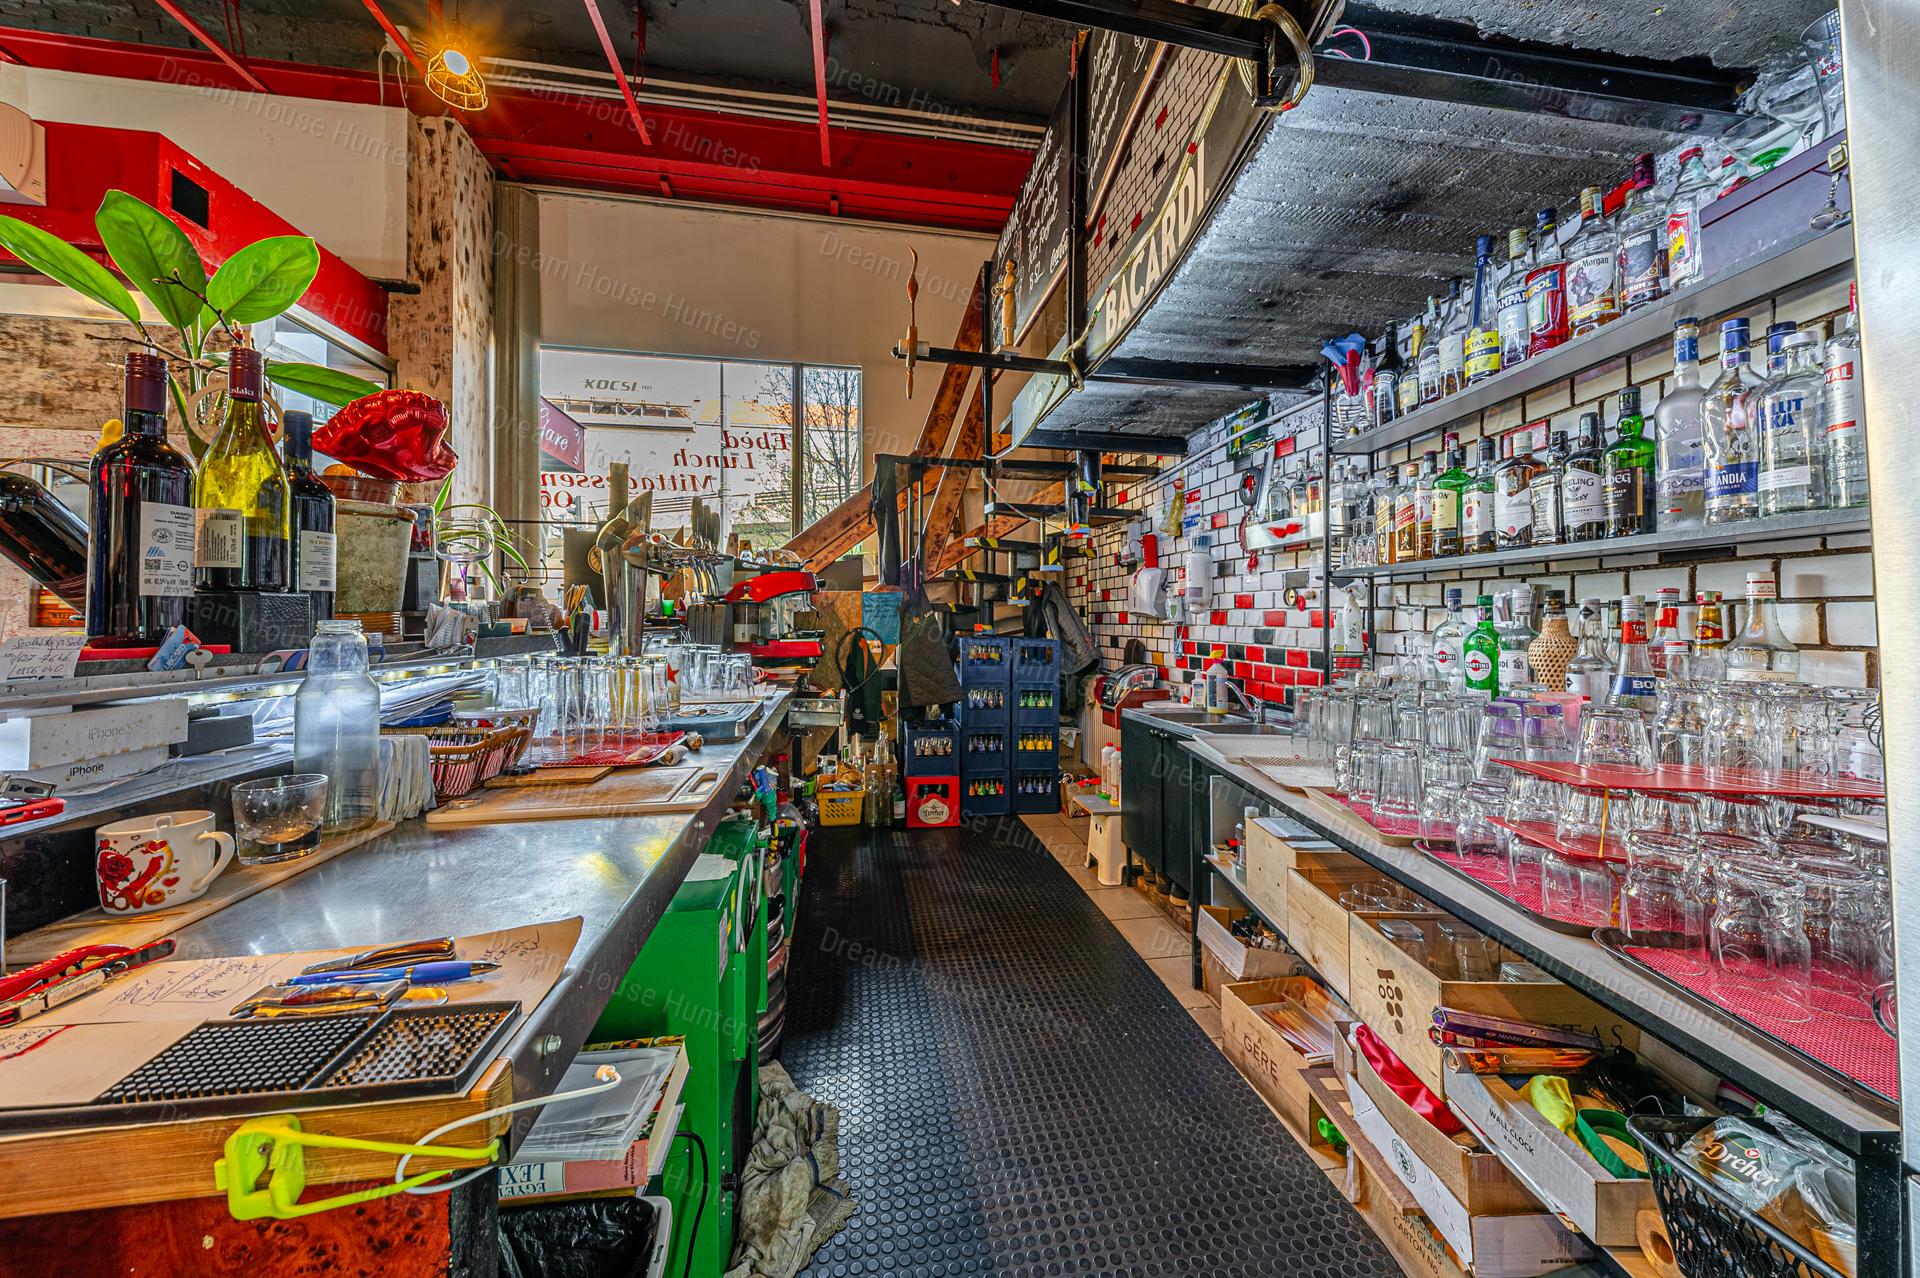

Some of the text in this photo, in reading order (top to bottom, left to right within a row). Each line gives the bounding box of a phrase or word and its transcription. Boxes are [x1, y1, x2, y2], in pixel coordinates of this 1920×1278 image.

[1105, 138, 1205, 342] BACARDI
[1622, 233, 1652, 249] Morgan
[1582, 256, 1610, 269] Morgan
[1703, 471, 1747, 489] FINLANDIA
[69, 763, 105, 777] iPhone
[1243, 1035, 1279, 1087] GERE
[1488, 1107, 1535, 1157] WALL CLOCK
[1703, 1141, 1780, 1187] Dreher
[1392, 1215, 1427, 1259] CARTON
[1416, 1230, 1443, 1266] GLASS
